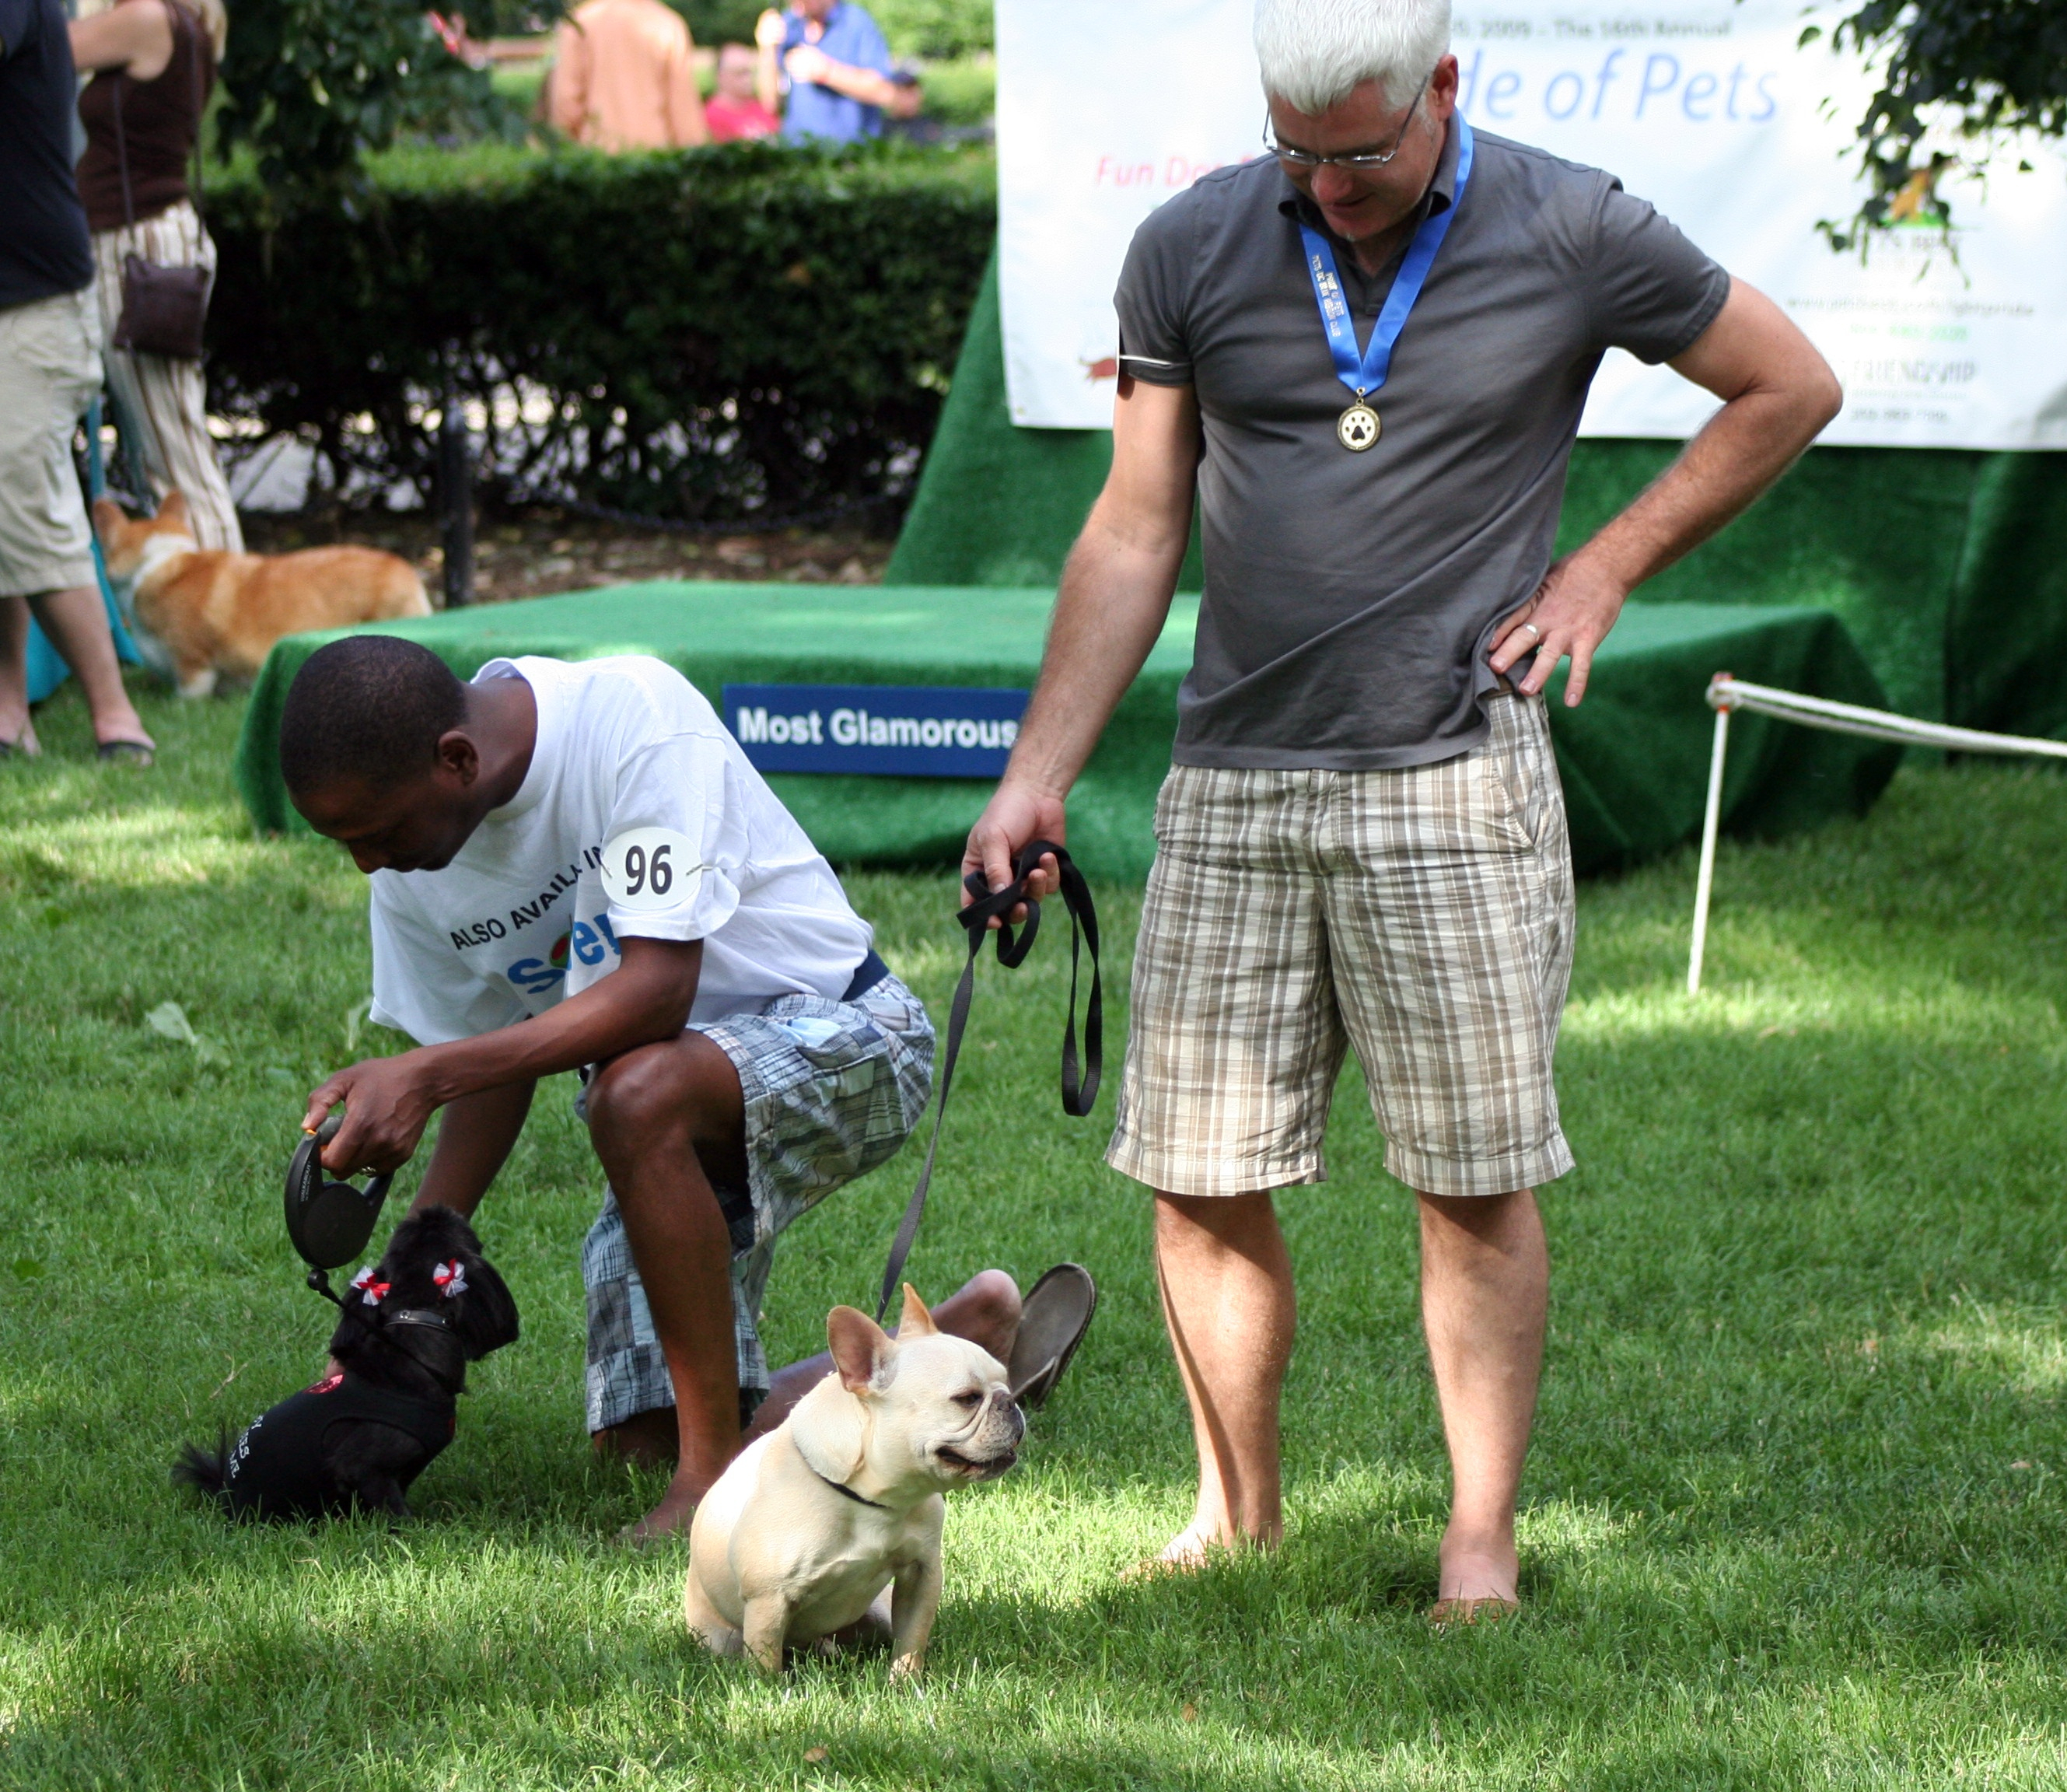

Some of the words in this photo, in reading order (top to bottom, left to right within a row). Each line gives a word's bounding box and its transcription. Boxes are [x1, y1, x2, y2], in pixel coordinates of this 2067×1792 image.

[1552, 18, 1593, 37] The
[1654, 18, 1734, 37] Annual
[1544, 46, 1625, 121] of
[1633, 52, 1779, 121] Pets
[1095, 154, 1155, 187] Fun
[736, 705, 824, 746] Most
[828, 706, 1020, 750] Glamorous
[624, 844, 673, 896] 96
[449, 917, 507, 951] ALSO
